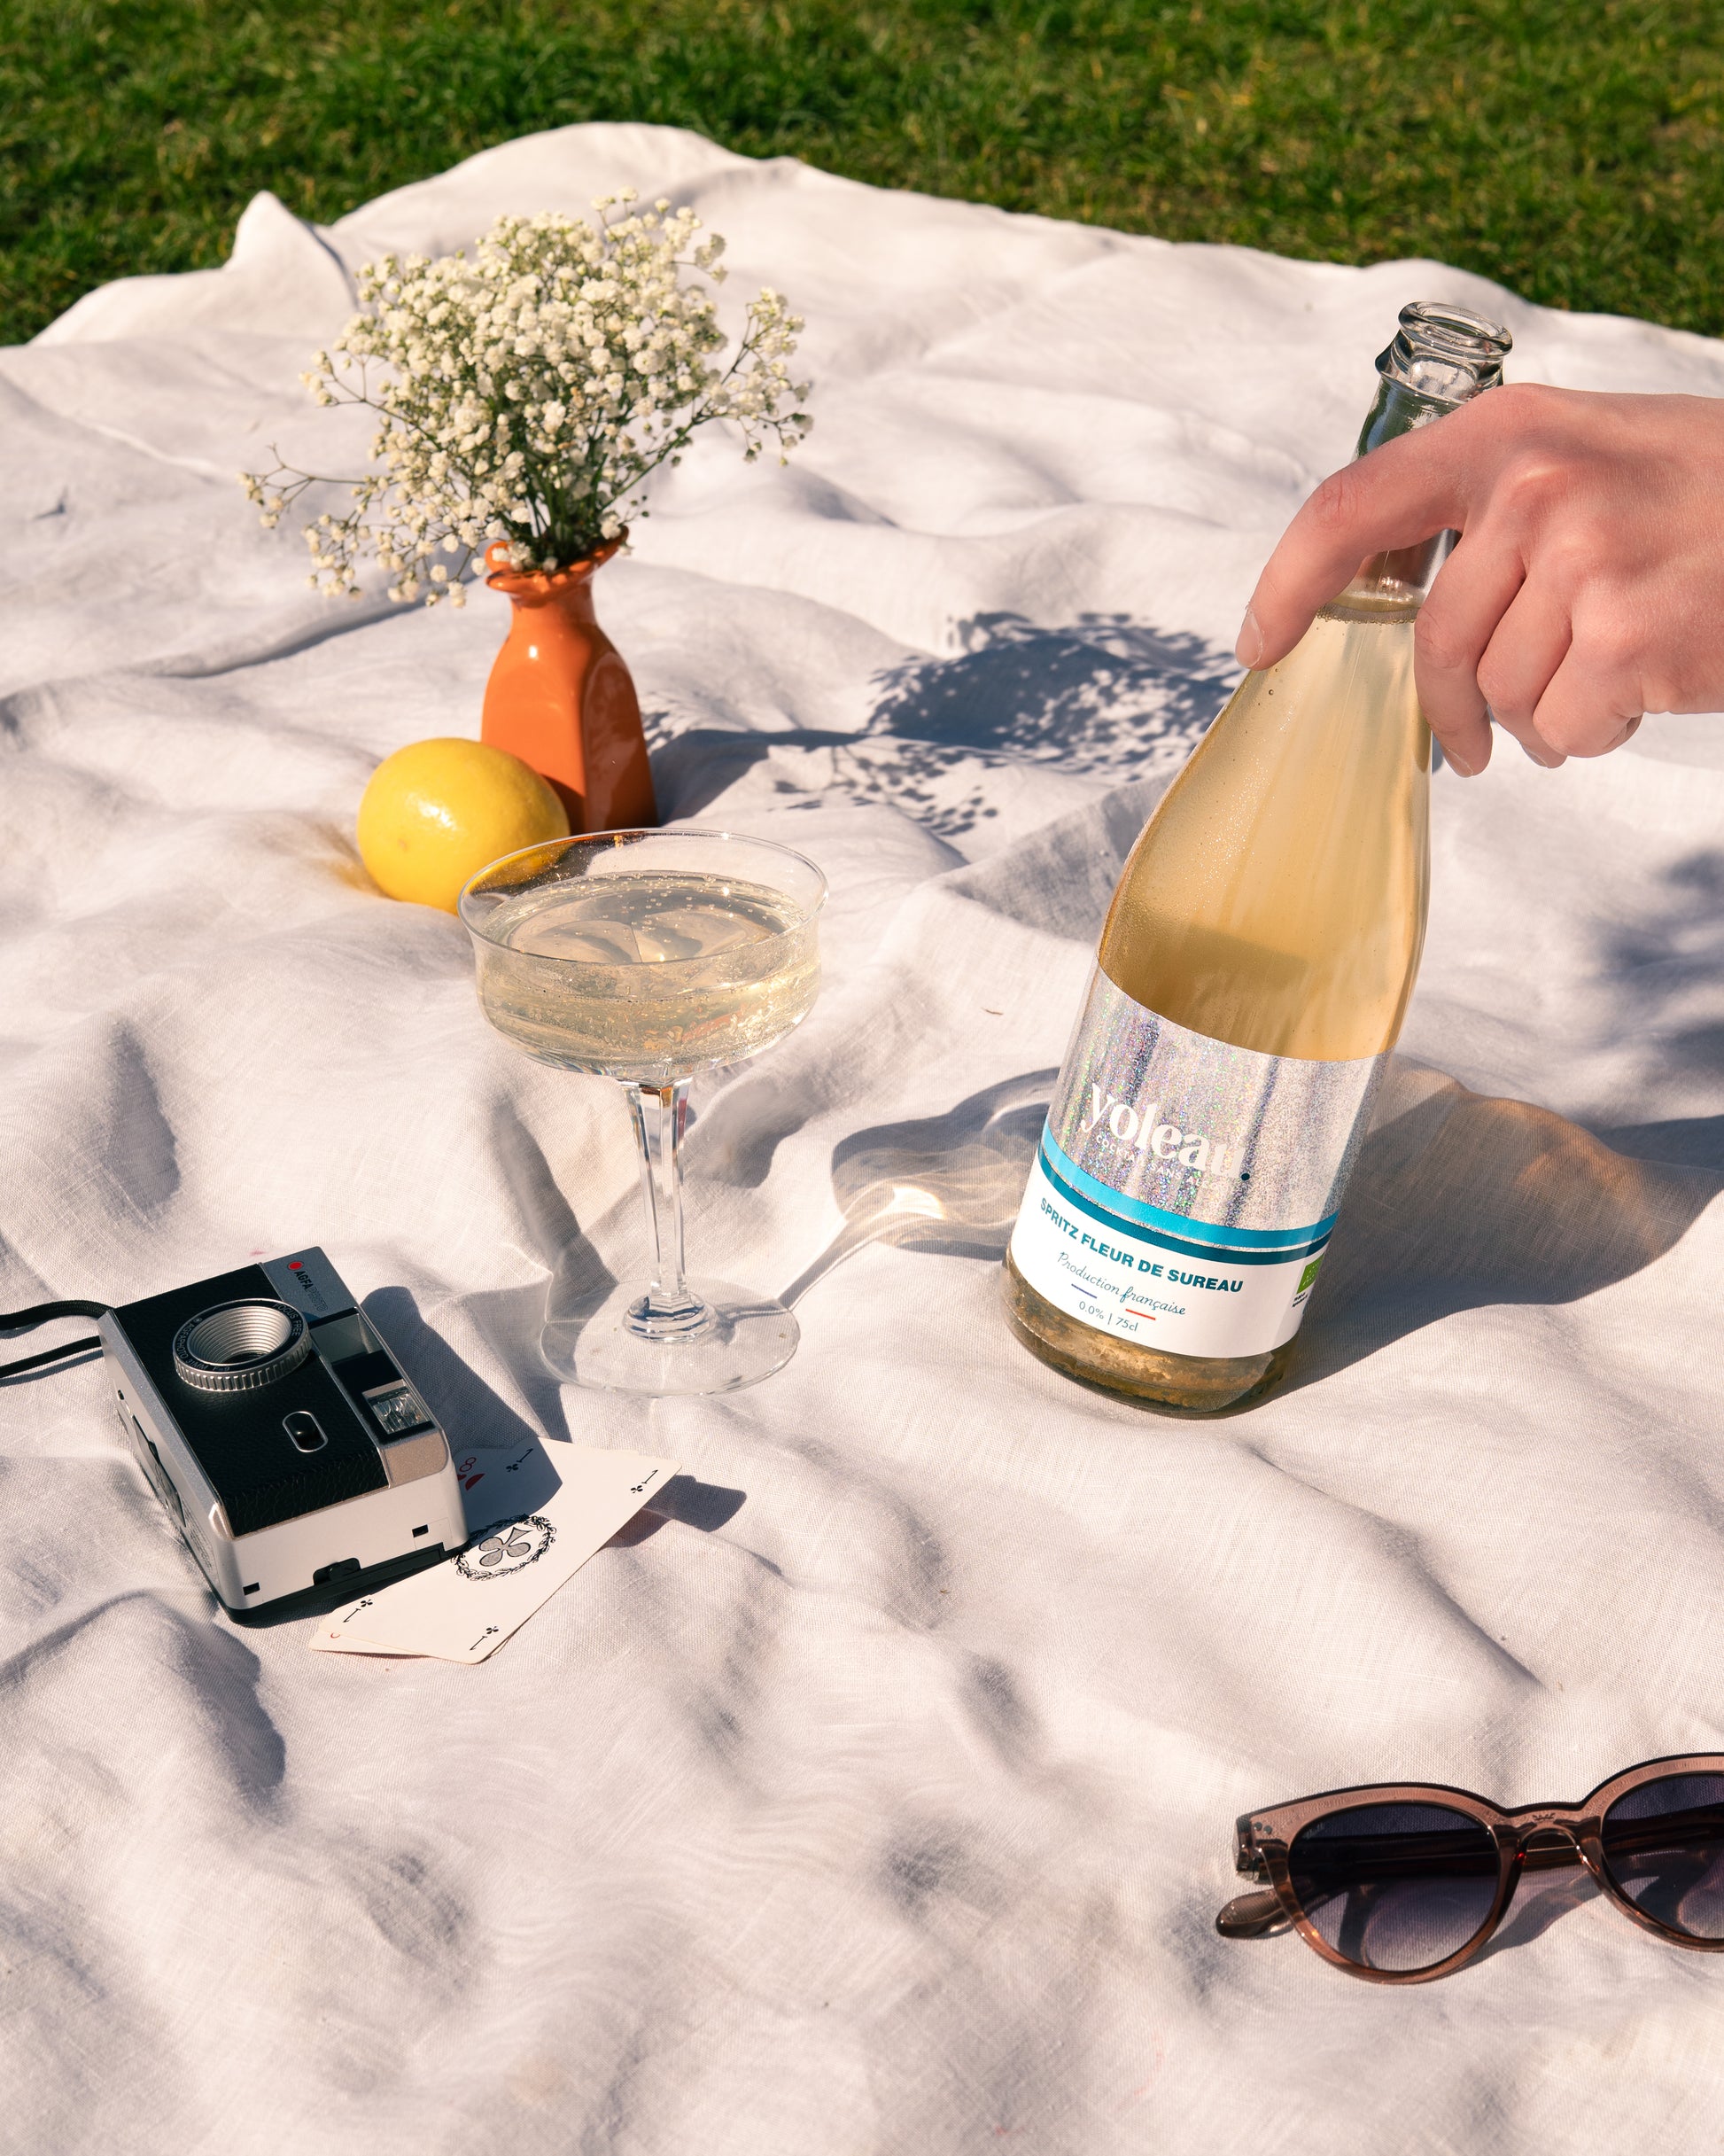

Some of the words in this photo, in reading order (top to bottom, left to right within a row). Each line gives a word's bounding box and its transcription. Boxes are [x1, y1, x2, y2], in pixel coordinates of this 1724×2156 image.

[1150, 1163, 1182, 1179] SANS
[1040, 1197, 1079, 1240] SPRITZ
[1081, 1233, 1134, 1268] FLEUR
[1138, 1258, 1164, 1277] DE
[1167, 1269, 1244, 1293] SUREAU
[1057, 1251, 1120, 1295] Production
[1119, 1286, 1186, 1315] française
[272, 1303, 299, 1319] FOCUS
[291, 1319, 303, 1337] FREE
[1079, 1300, 1104, 1319] 0.0%
[1115, 1316, 1138, 1332] 75cl
[176, 1323, 195, 1359] AGFAPHOTO
[185, 1358, 209, 1371] 31MM
[459, 1456, 477, 1473] 8
